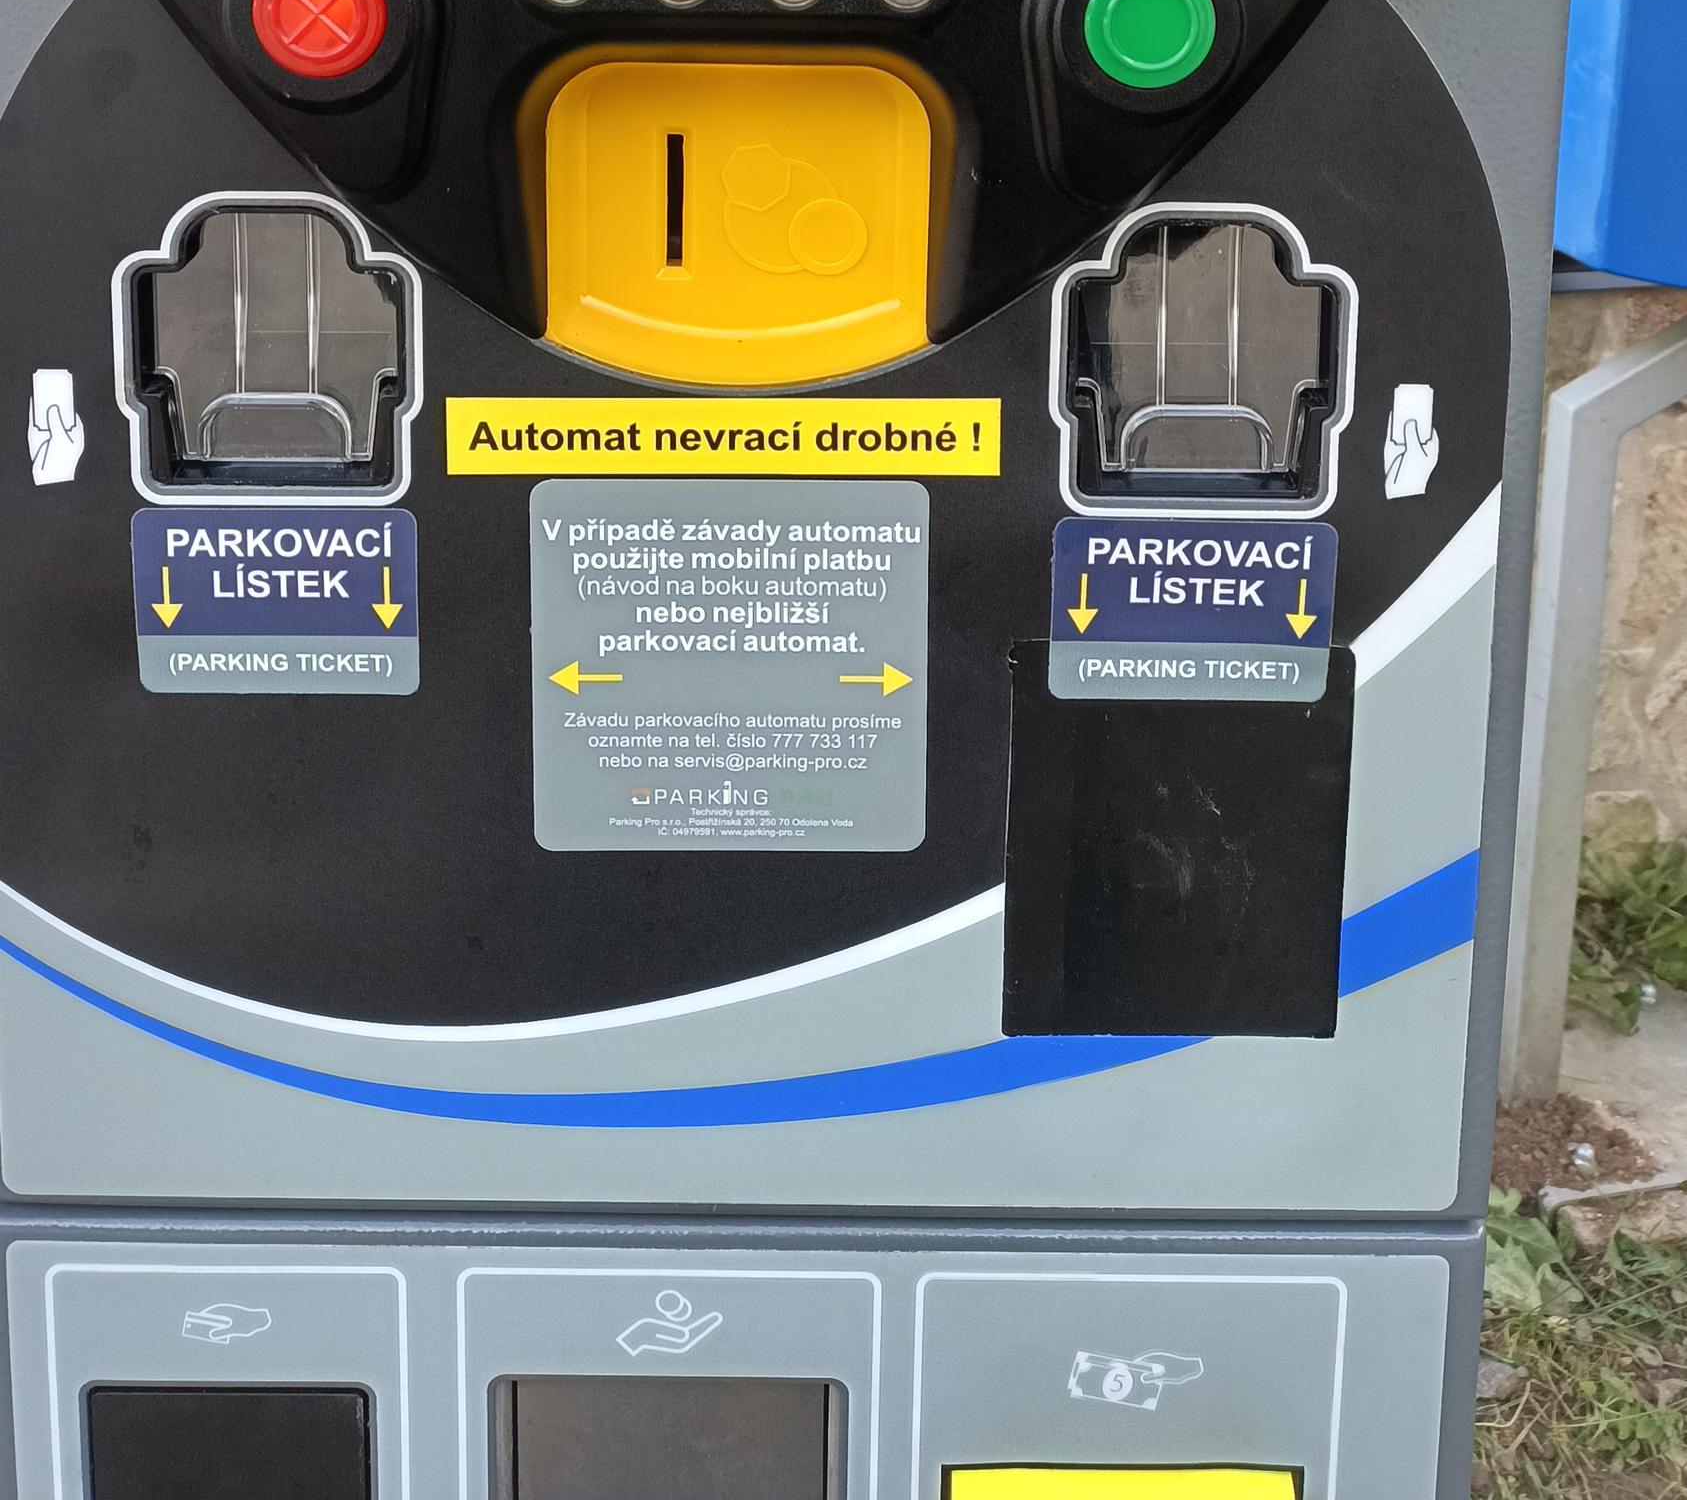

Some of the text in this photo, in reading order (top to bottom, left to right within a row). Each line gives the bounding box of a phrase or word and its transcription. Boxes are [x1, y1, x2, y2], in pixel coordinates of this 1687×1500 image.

[469, 422, 641, 451] Automat
[656, 422, 801, 451] nevrací
[816, 422, 956, 451] drobné
[167, 522, 392, 557] PARKOVACÍ
[542, 519, 920, 546] V případě závady automatu
[574, 547, 890, 575] použijte mobilní platbu
[1088, 536, 1313, 569] PARKOVACÍ
[213, 564, 349, 597] LÍSTEK
[579, 575, 886, 601] (návod na boku automatu)
[1130, 571, 1264, 606] LÍSTEK
[637, 601, 829, 628] nebo nejbližší
[600, 629, 864, 656] parkovací automat.
[170, 653, 392, 677] (PARKING TICKET)
[1079, 659, 1299, 684] (PARKING TICKET)
[564, 713, 901, 731] Závadu parkovacího automatu prosíme
[589, 733, 877, 748] oznamte na tel. číslo 777 733 117
[600, 753, 867, 771] nebo na servis@parking-pro.cz
[655, 781, 768, 805] PARKING
[1110, 1373, 1126, 1393] 5
